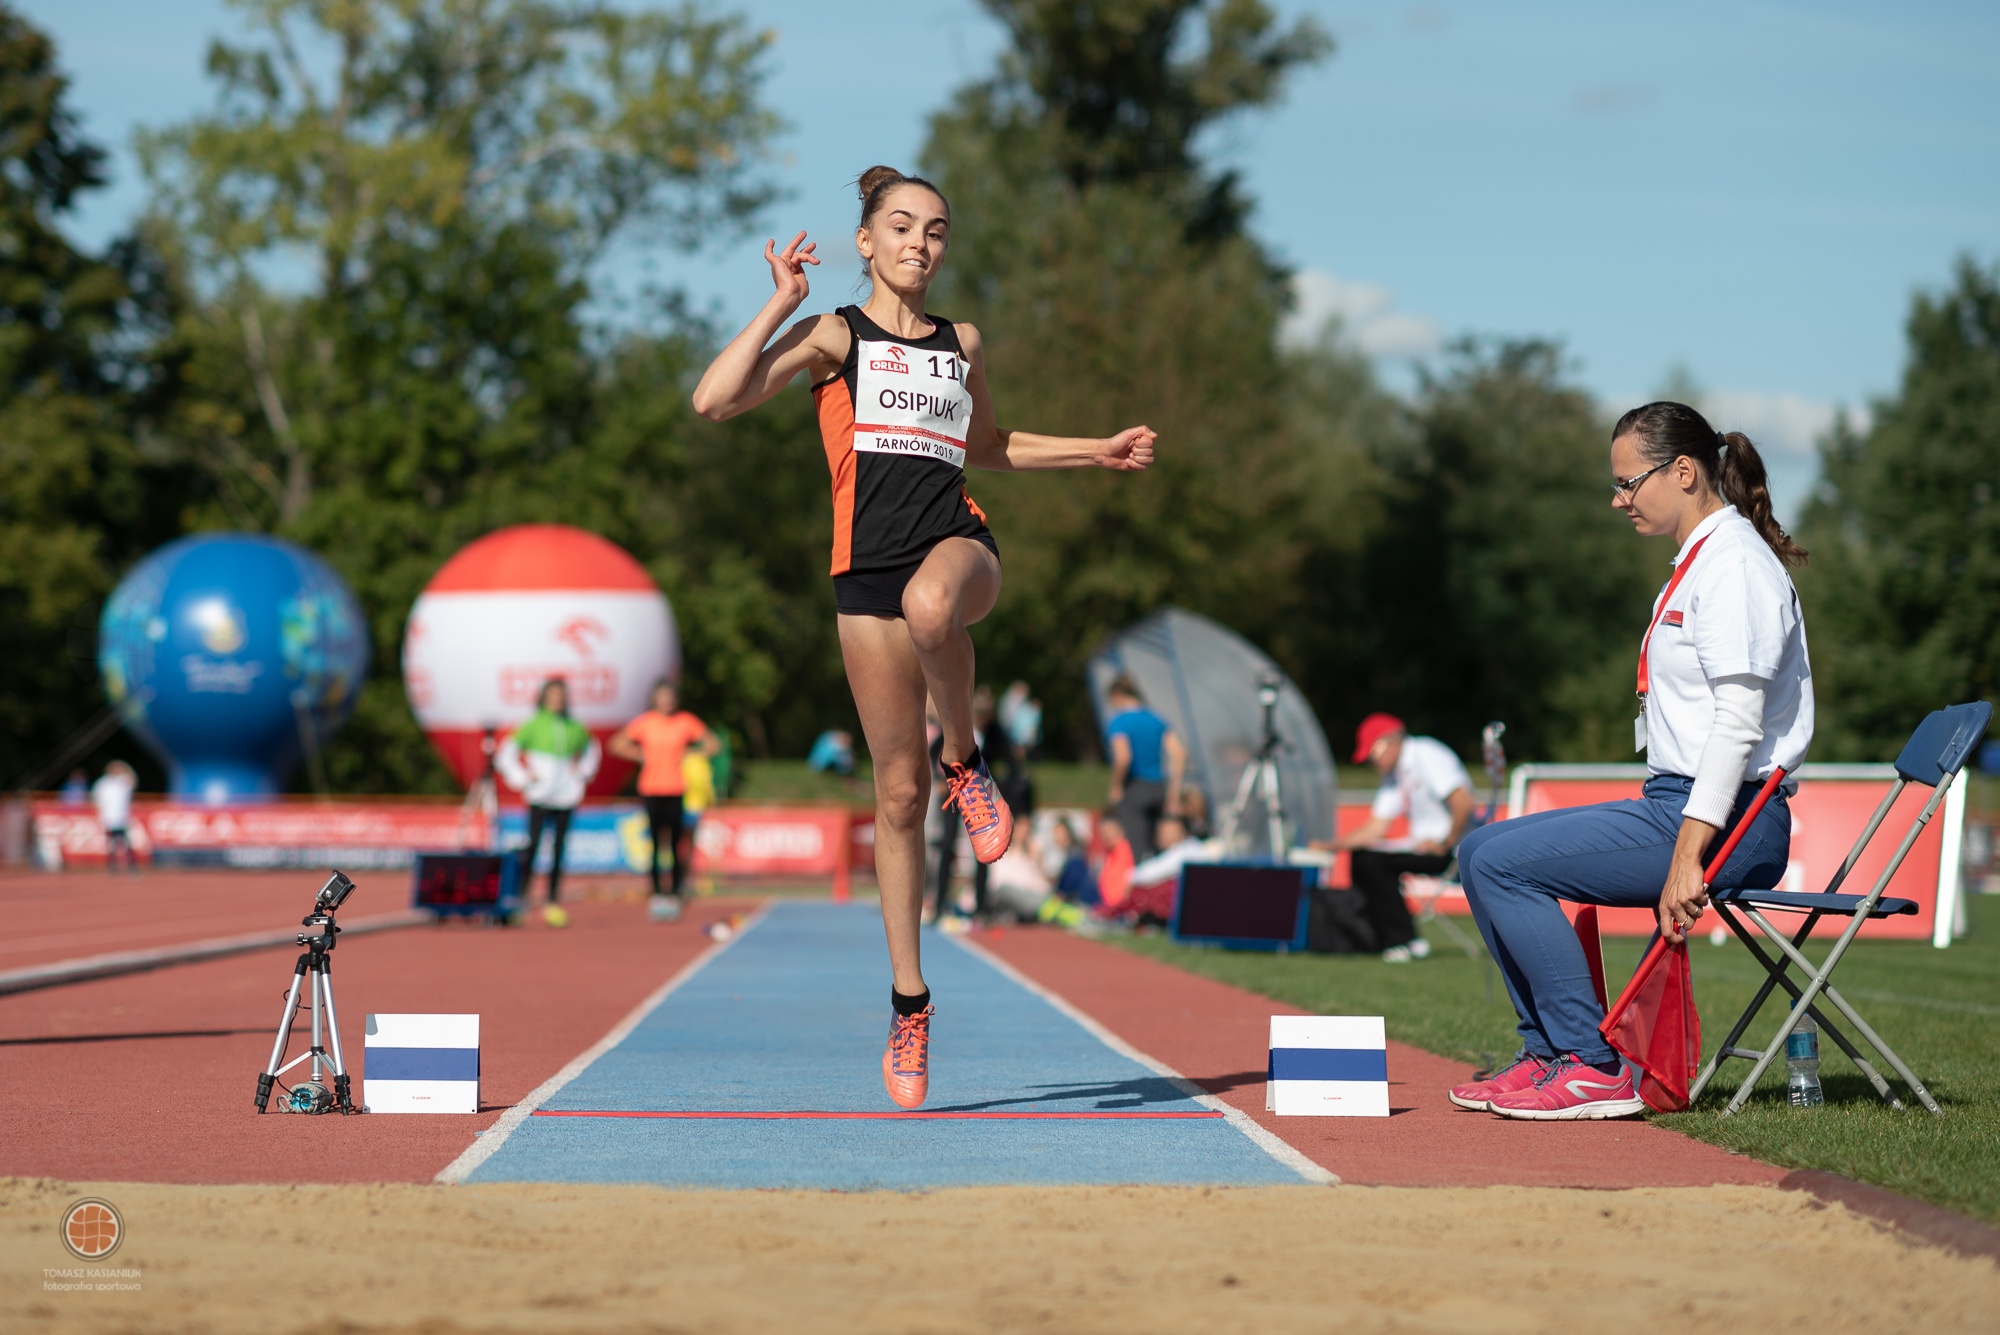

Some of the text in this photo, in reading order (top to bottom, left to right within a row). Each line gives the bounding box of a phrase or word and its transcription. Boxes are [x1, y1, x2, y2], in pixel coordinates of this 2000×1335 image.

[871, 361, 907, 373] ORLEN
[879, 388, 958, 421] OSIPIUK
[876, 437, 931, 453] TARNÓW
[934, 444, 954, 460] 2019
